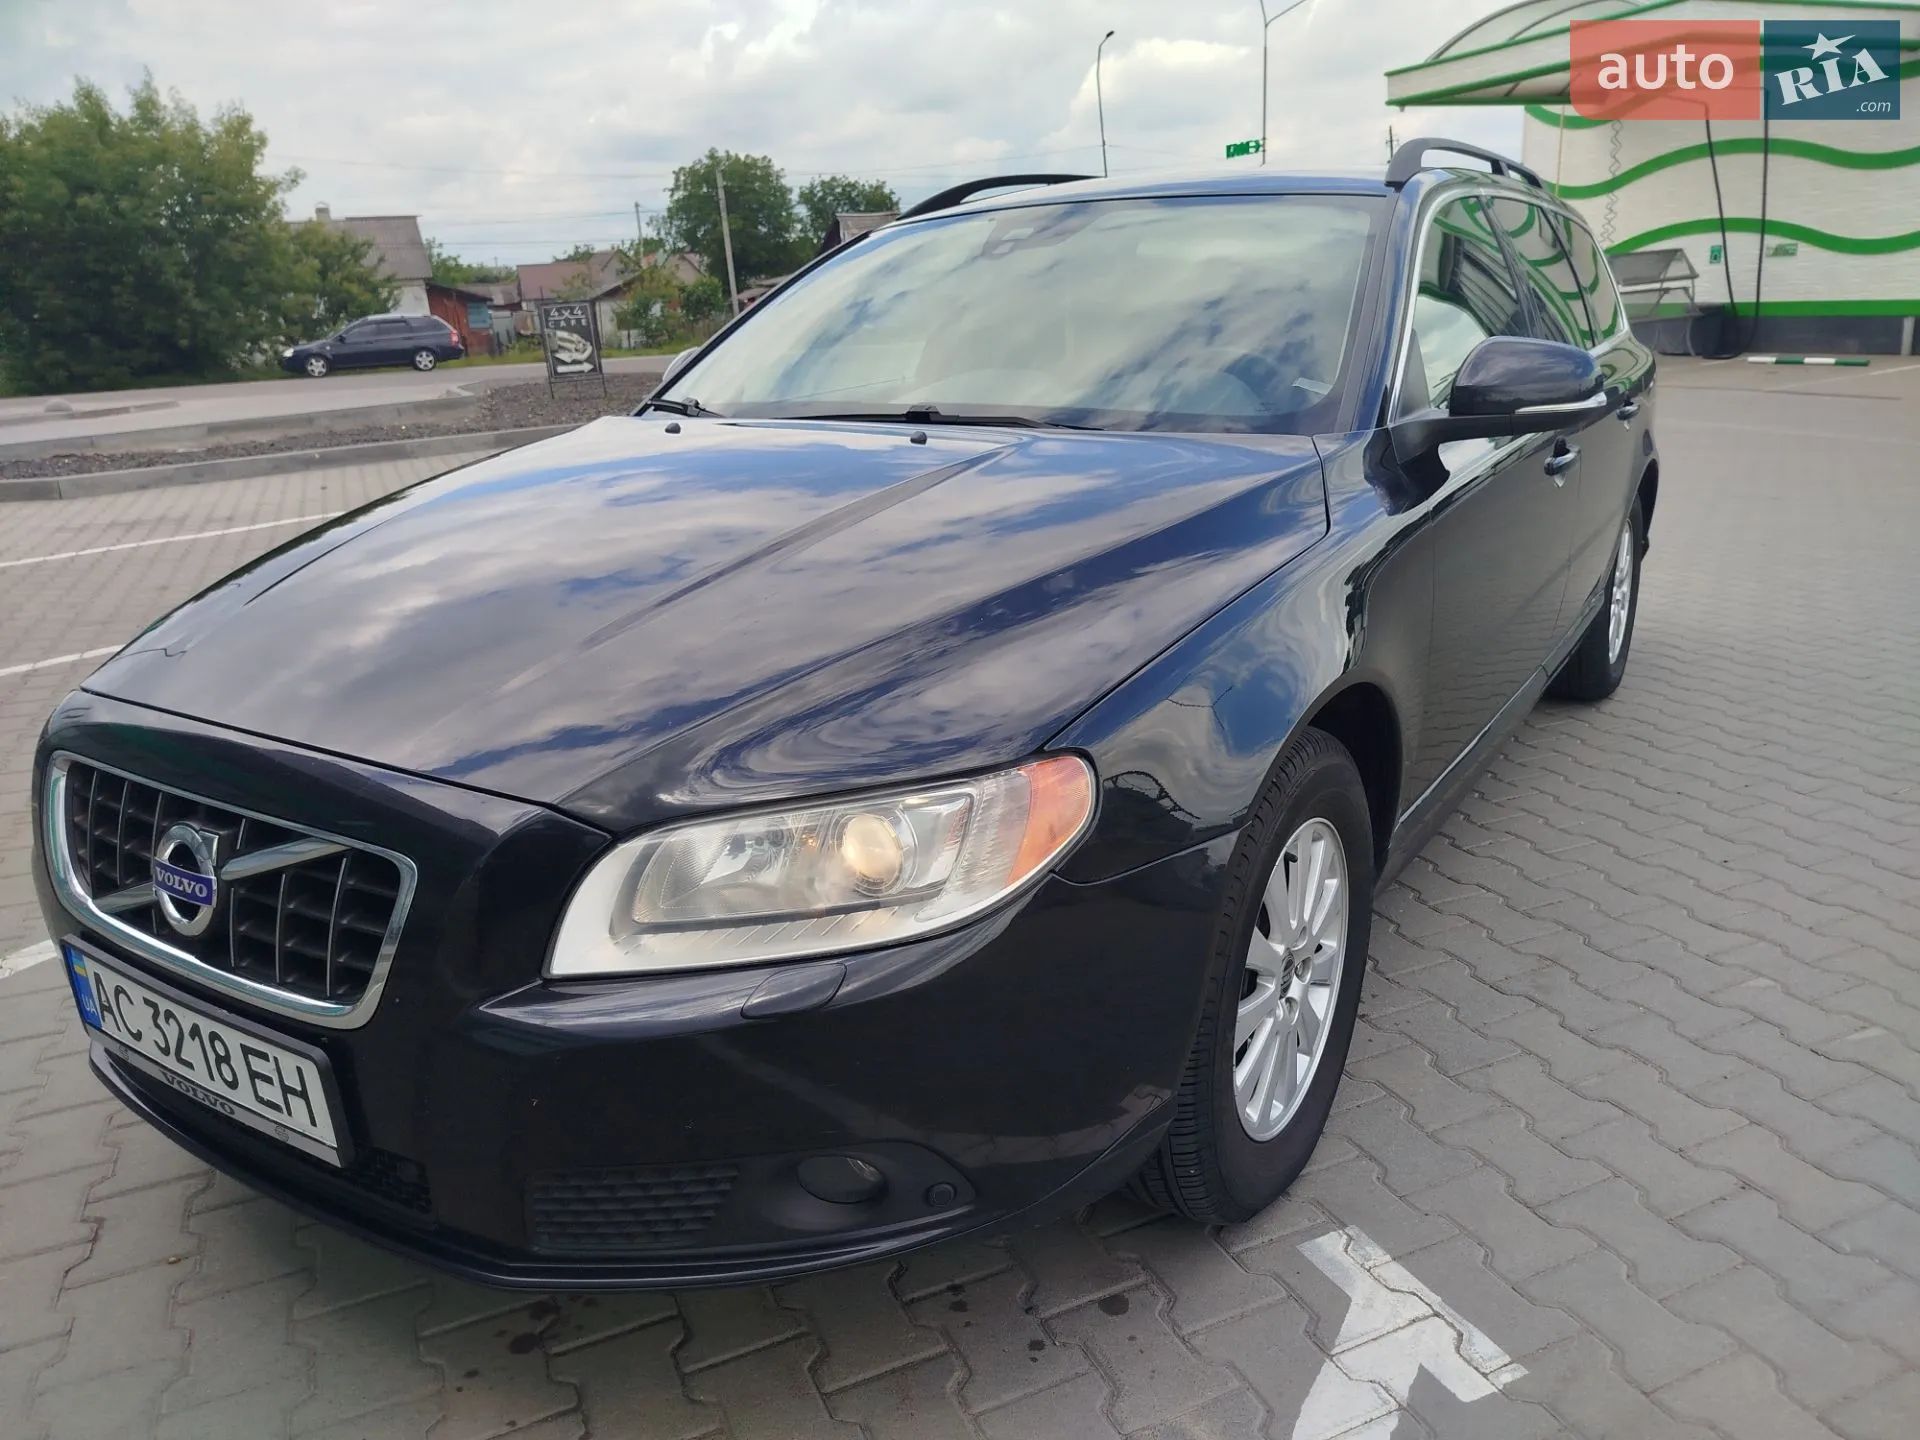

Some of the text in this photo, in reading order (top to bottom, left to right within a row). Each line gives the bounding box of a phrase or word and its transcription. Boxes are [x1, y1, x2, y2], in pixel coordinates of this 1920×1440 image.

[155, 866, 208, 898] VOLVO
[81, 993, 98, 1016] UA
[93, 971, 318, 1128] AC 3218 EH
[159, 1068, 236, 1116] VOLVO
